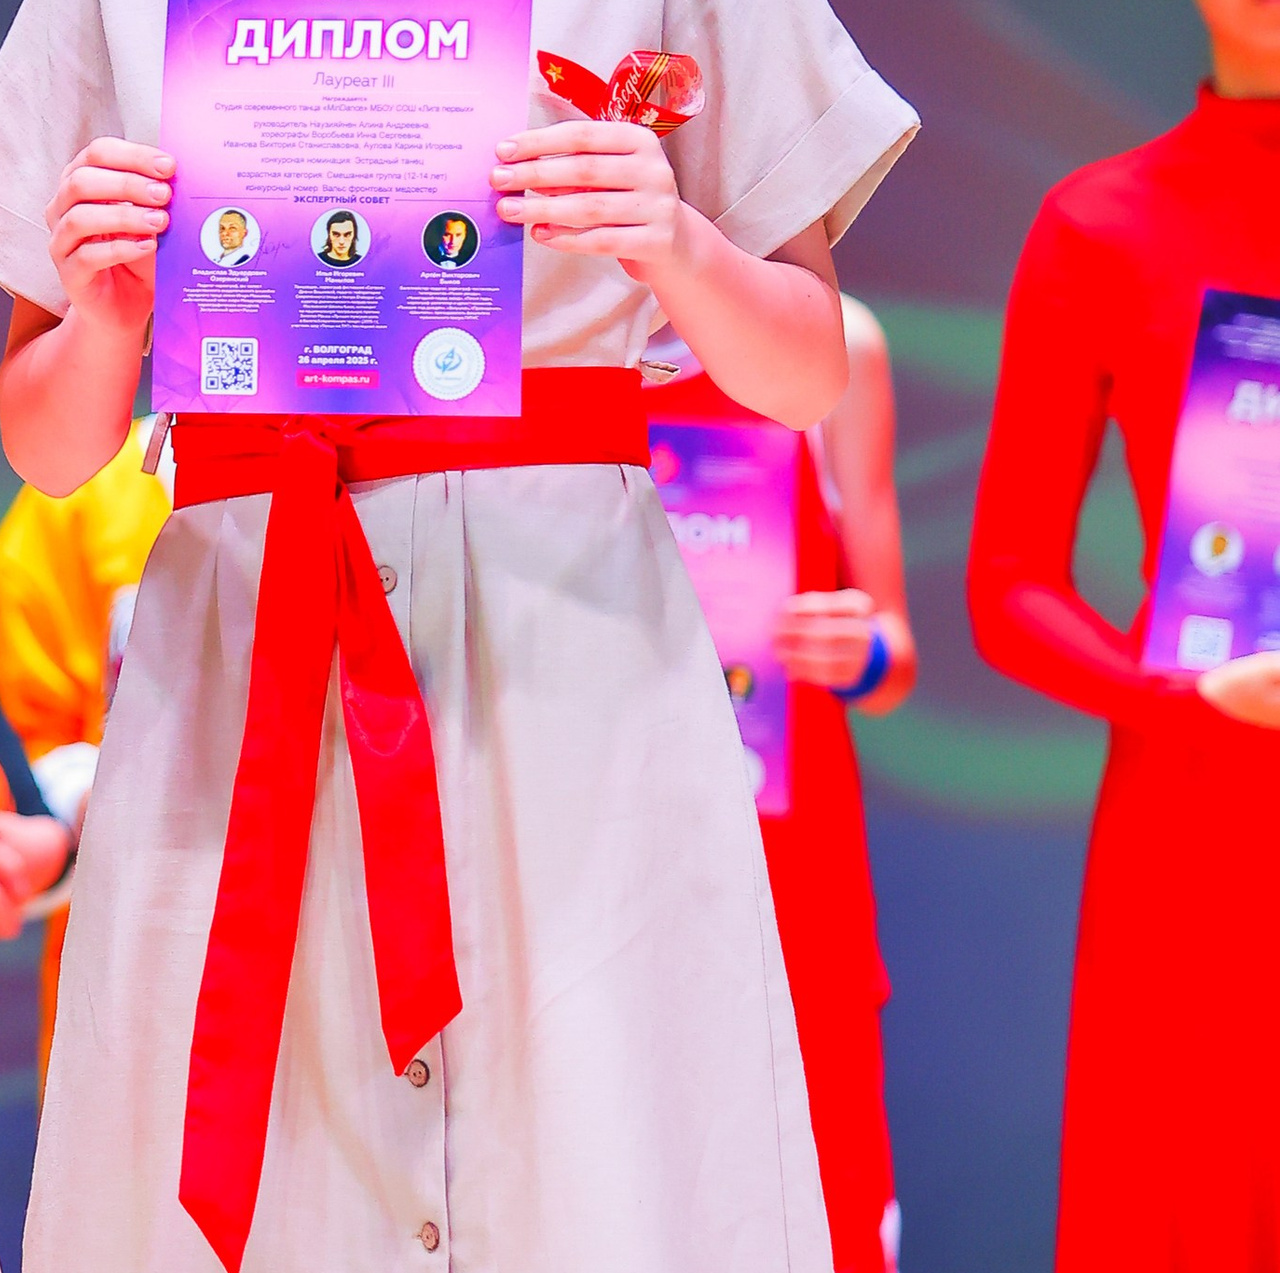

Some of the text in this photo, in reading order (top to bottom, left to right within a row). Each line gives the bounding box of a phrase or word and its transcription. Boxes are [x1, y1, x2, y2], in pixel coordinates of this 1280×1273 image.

[226, 18, 470, 65] ДИПЛОМ
[313, 71, 395, 89] Лауреат III
[214, 102, 242, 111] Студия
[243, 103, 297, 111] современного
[370, 104, 393, 112] МБОУ
[395, 104, 417, 113] СОШ
[253, 121, 308, 129] руководитель
[359, 121, 384, 129] Алина
[260, 130, 310, 139] хореографы
[312, 130, 355, 139] Воробьева
[356, 130, 377, 139] Инна
[223, 140, 258, 149] Иванова
[259, 140, 297, 149] Виктория
[394, 142, 423, 151] Карина
[425, 142, 463, 151] Игоревна
[261, 157, 305, 165] конкурсная
[355, 156, 399, 166] Эстрадный
[401, 158, 425, 166] танец
[236, 171, 281, 179] возрастная
[326, 170, 374, 179] Смешанная
[375, 172, 402, 181] группа
[403, 171, 428, 181] (12-14
[430, 172, 448, 181] лет)
[245, 183, 291, 193] конкурсный
[322, 184, 347, 193] Вальс
[348, 185, 393, 194] фронтовых
[395, 186, 438, 195] медсестер
[293, 194, 390, 204] ЭКСПЕРТНЫЙ СОВЕТ
[303, 345, 373, 355] г. ВОЛГОГРАД
[297, 355, 310, 364] 26
[311, 357, 345, 366] апреля
[346, 356, 369, 365] 2025
[303, 374, 371, 385] art-kompas.ru
